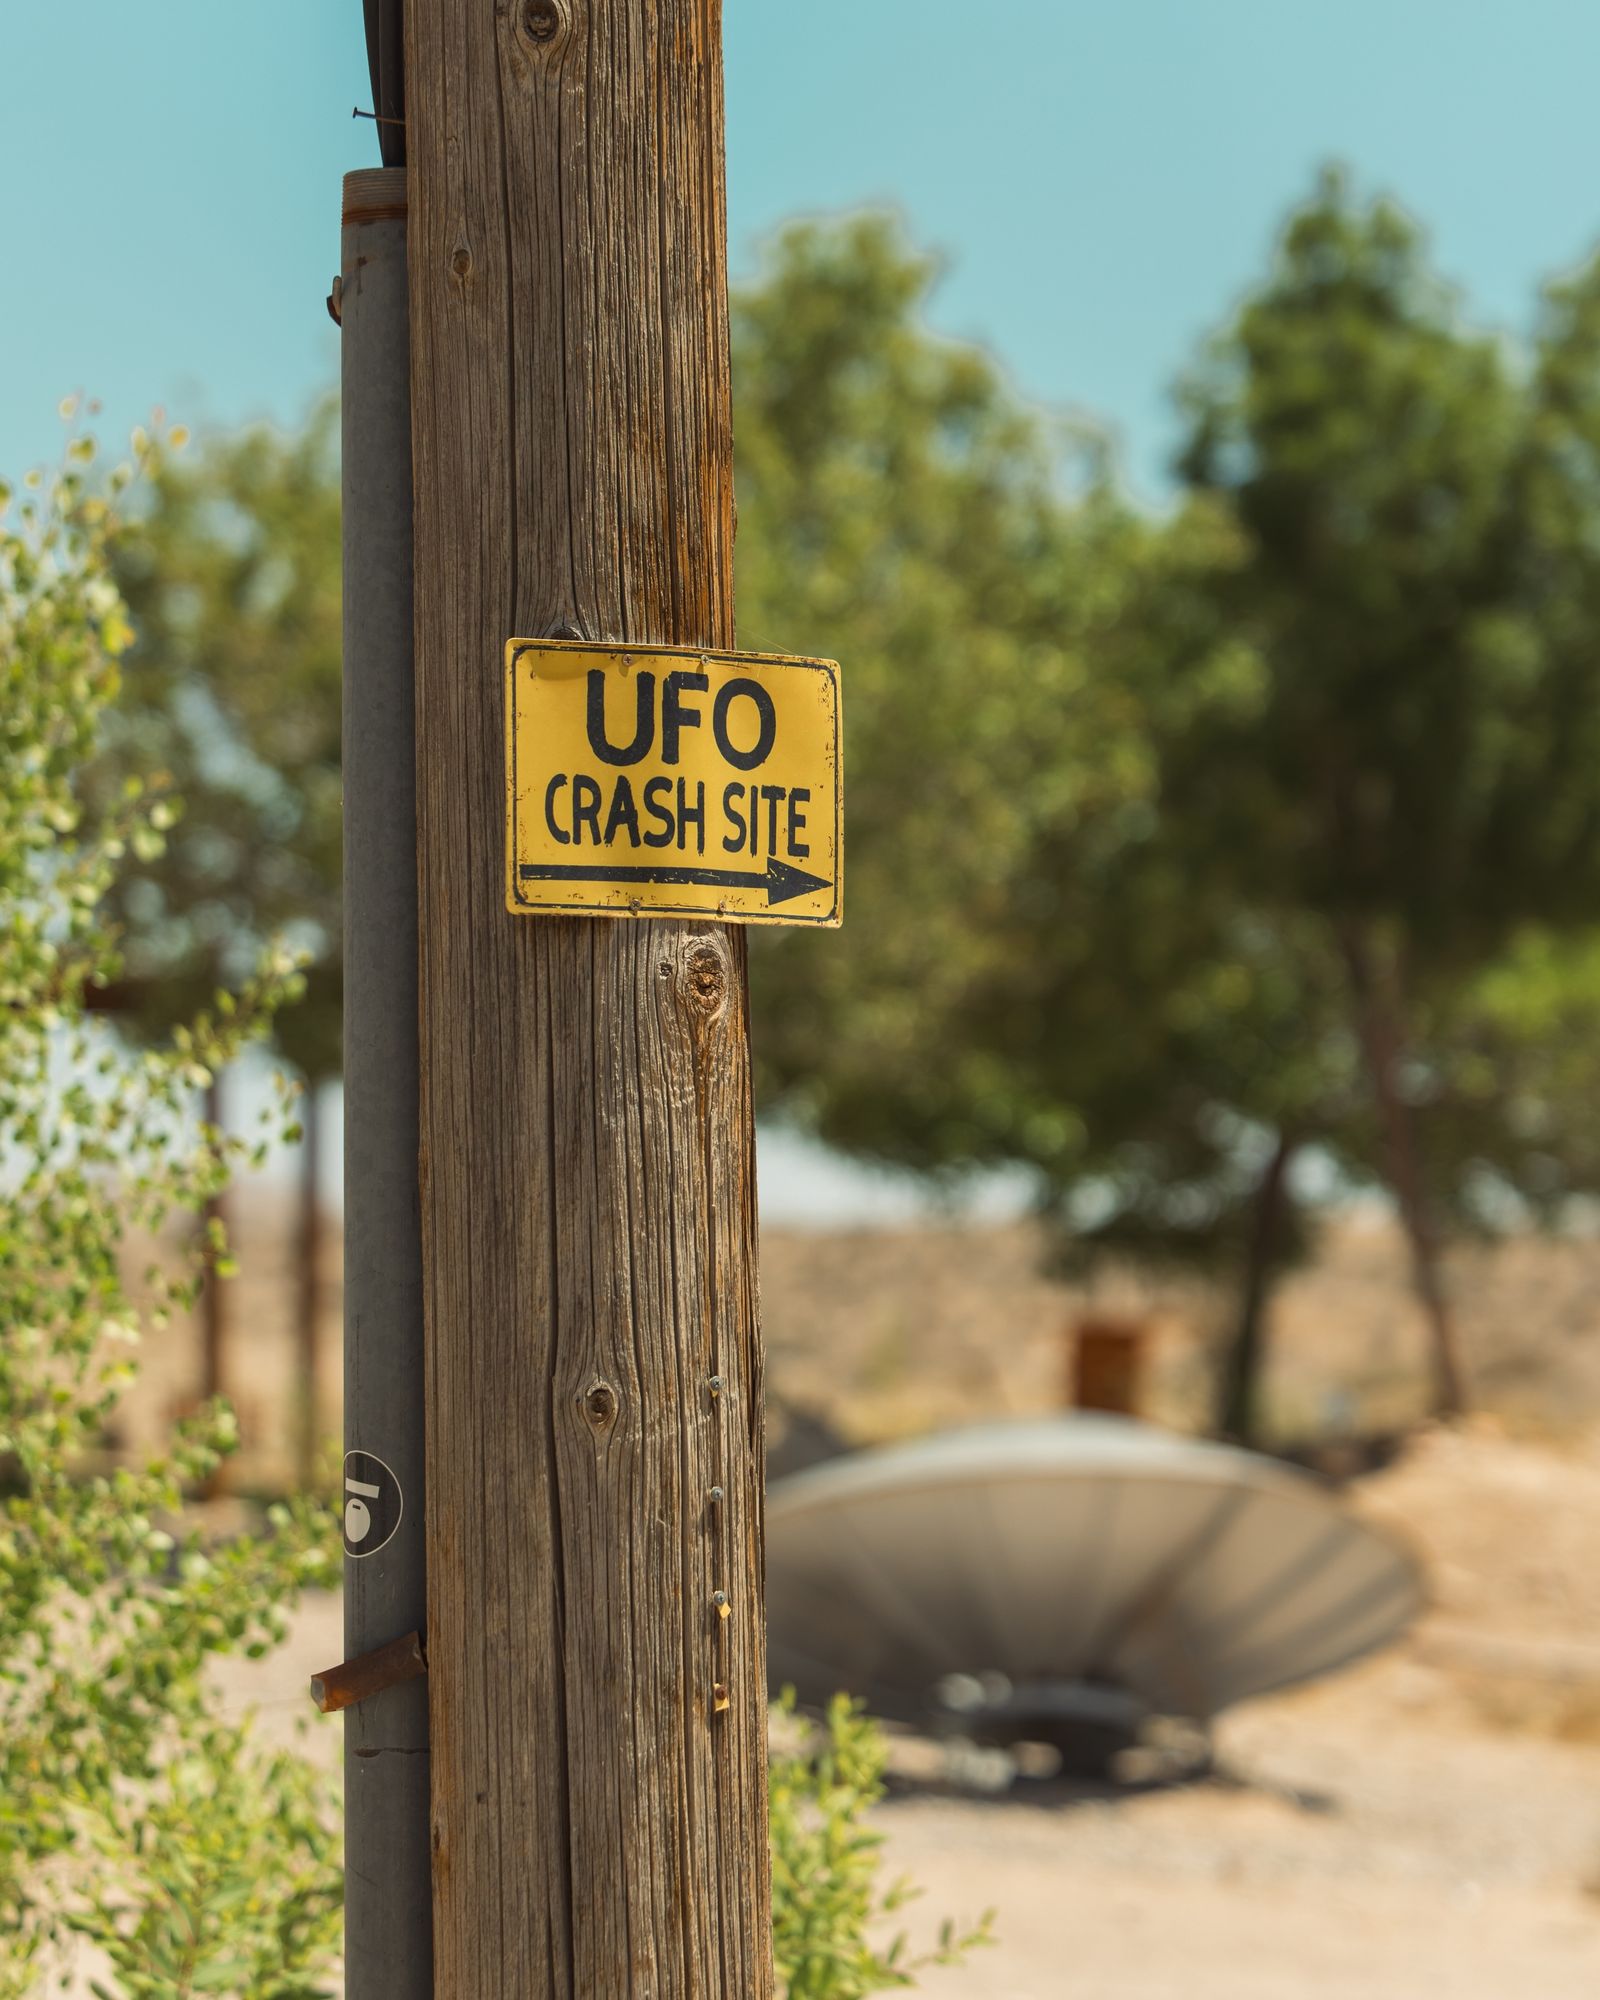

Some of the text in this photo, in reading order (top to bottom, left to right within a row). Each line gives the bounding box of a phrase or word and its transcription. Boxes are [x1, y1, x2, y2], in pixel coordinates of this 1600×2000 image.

[586, 669, 777, 771] UFO
[545, 773, 811, 858] CRASH SITE
